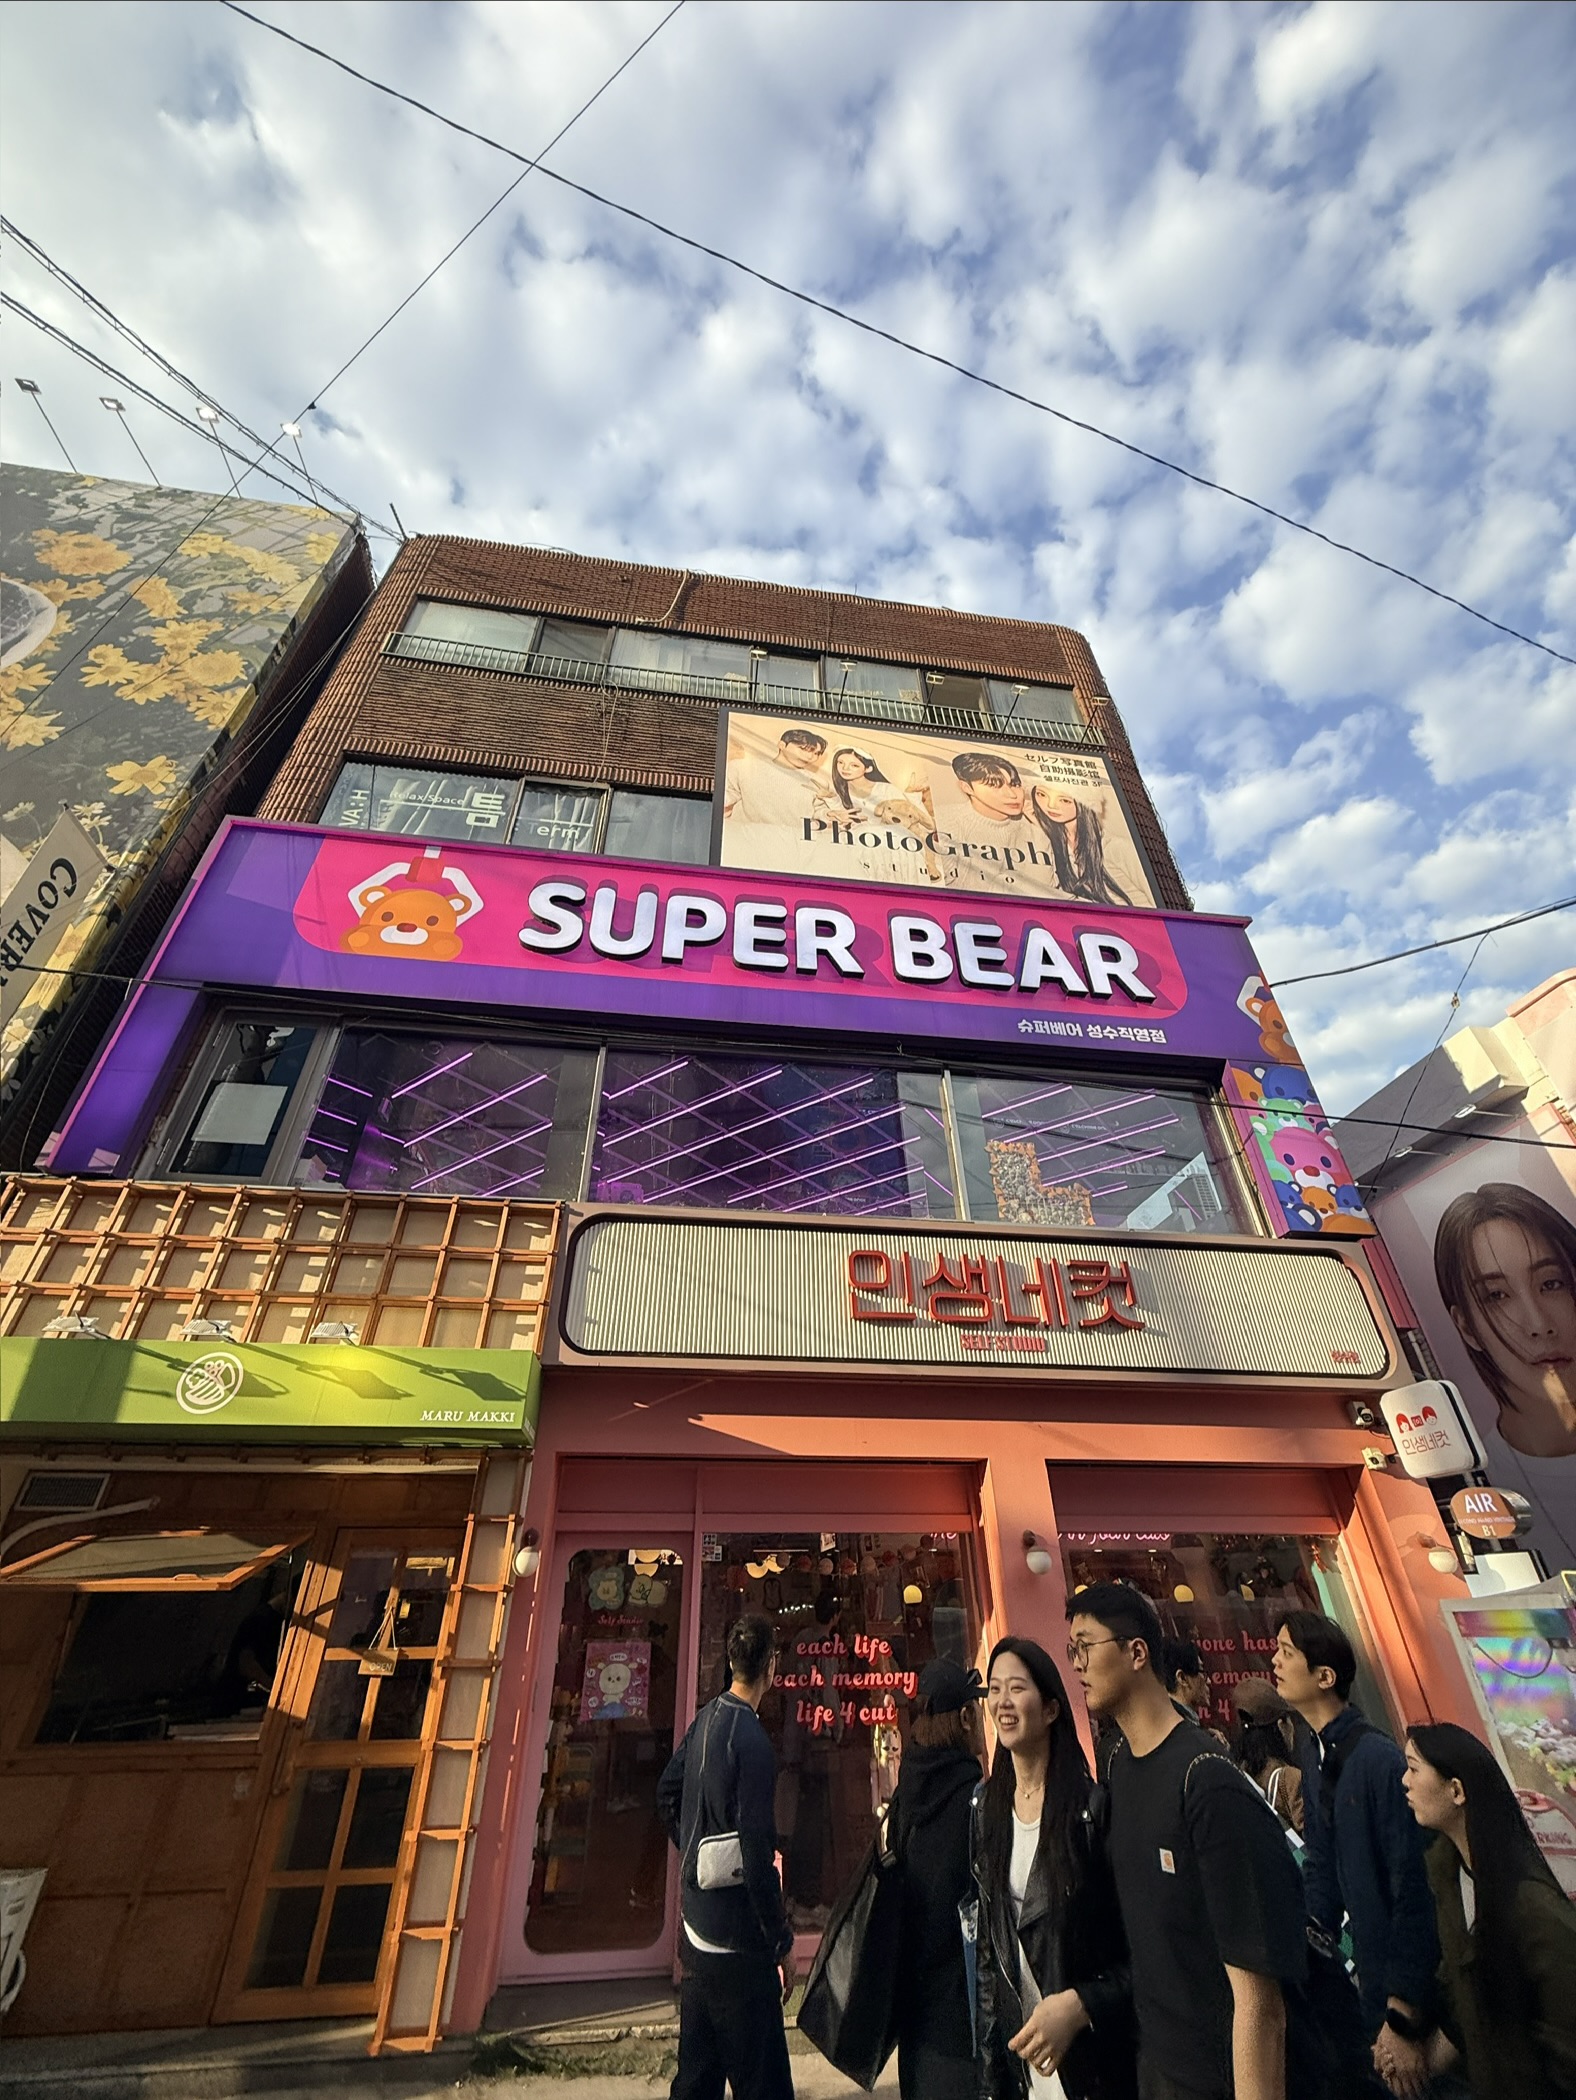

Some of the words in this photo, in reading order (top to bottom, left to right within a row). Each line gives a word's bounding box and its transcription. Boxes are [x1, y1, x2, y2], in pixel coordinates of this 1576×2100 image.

[427, 794, 465, 806] Space
[800, 817, 1053, 871] PhotoGraph
[862, 861, 1015, 885] studio
[0, 858, 78, 987] COVER
[518, 882, 866, 979] SUPER
[889, 915, 1157, 1004] BEAR
[1017, 1019, 1084, 1038] 슈퍼베어
[1086, 1023, 1168, 1044] 성수직영점
[848, 1250, 1145, 1330] 인생네컷
[960, 1334, 992, 1350] SELF
[420, 1410, 464, 1422] MARU
[466, 1411, 516, 1423] MAKKI
[1401, 1429, 1452, 1456] 인생네컷
[1464, 1493, 1498, 1514] AIR
[1481, 1525, 1497, 1537] B1
[796, 1633, 847, 1656] each
[853, 1633, 891, 1665] life
[773, 1664, 825, 1688] each
[832, 1671, 917, 1697] memory
[796, 1700, 835, 1734] life
[839, 1701, 855, 1726] 4
[859, 1703, 897, 1723] cut
[1217, 1698, 1231, 1722] 4
